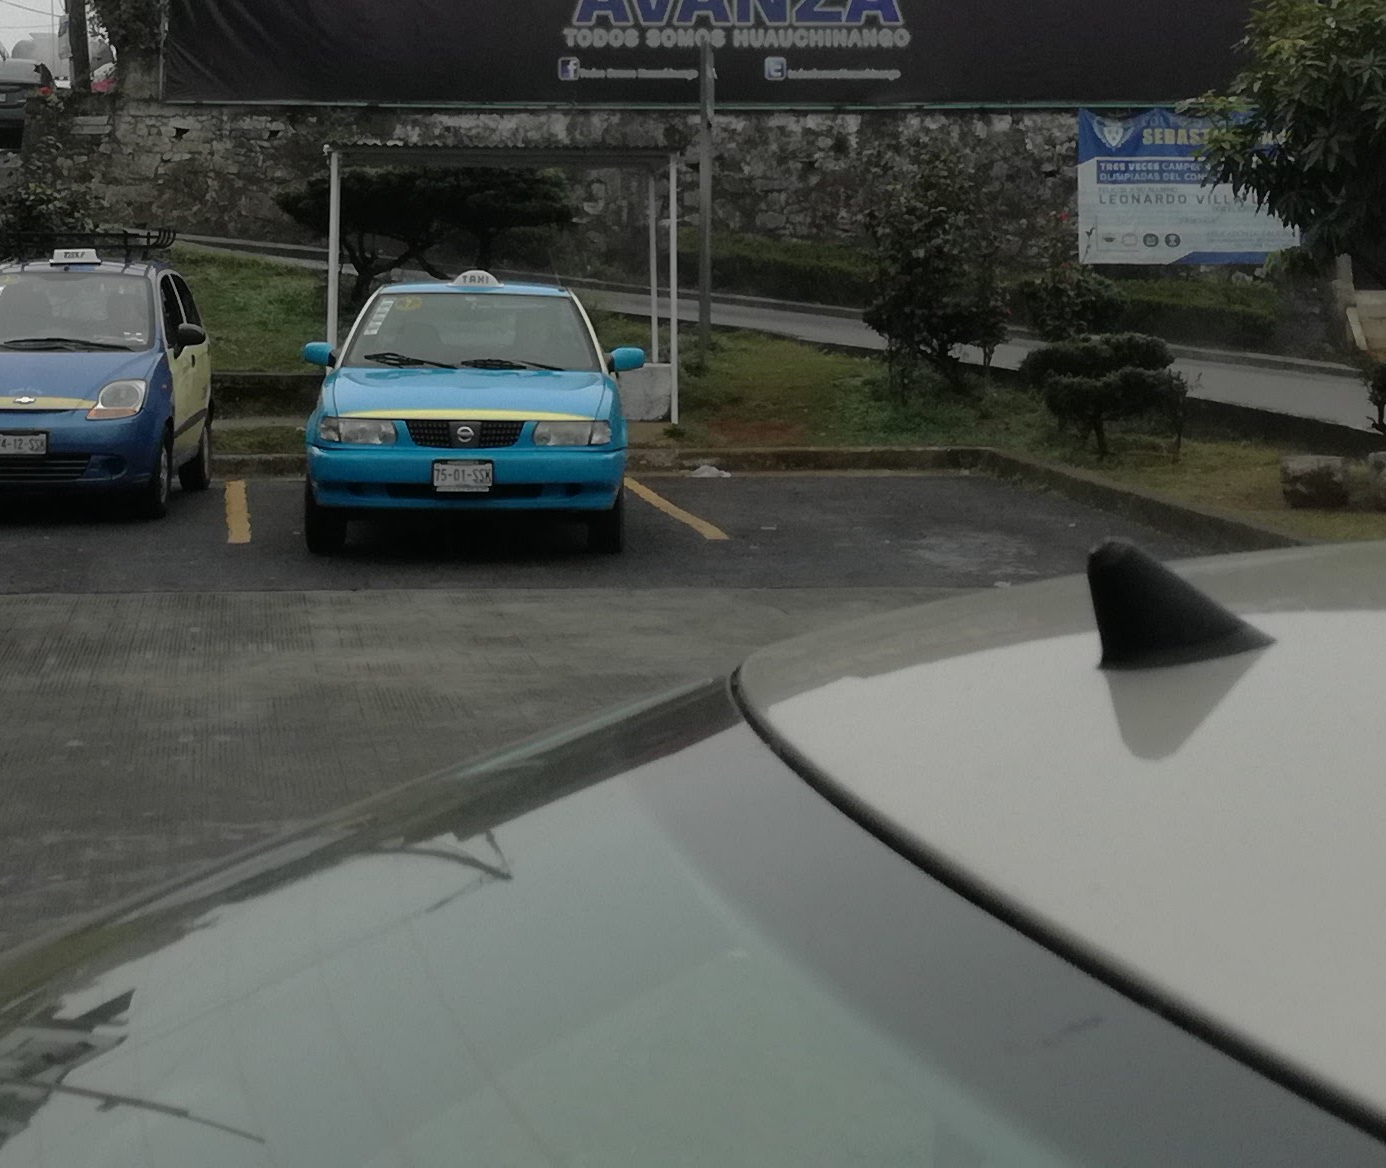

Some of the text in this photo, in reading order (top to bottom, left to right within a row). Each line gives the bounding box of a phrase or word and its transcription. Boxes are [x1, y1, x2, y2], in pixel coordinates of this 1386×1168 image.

[563, 27, 911, 48] TODOS SOMOS HUAUCHINANGO
[1098, 193, 1188, 206] LEONARDO
[461, 274, 489, 284] TAXI
